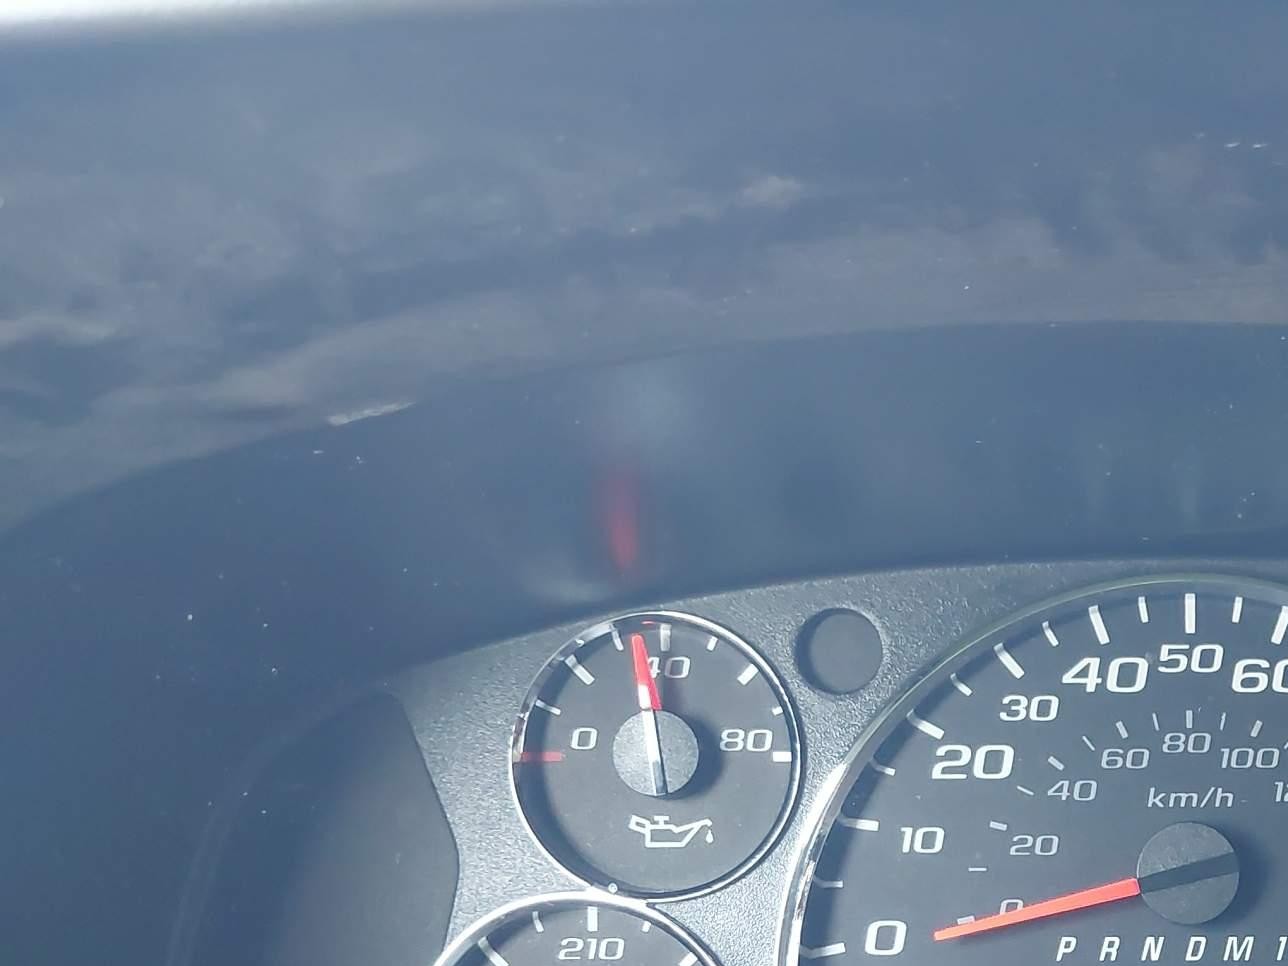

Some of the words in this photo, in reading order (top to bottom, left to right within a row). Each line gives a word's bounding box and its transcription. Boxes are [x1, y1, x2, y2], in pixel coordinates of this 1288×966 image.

[1158, 644, 1223, 673] 50
[1062, 657, 1149, 693] 40
[999, 695, 1060, 722] 30
[571, 727, 598, 750] 0
[719, 728, 774, 752] 80
[1162, 732, 1212, 753] 80
[931, 744, 1015, 780] 20
[1101, 748, 1150, 769] 60
[1220, 747, 1280, 769] 100
[1047, 780, 1098, 801] 40
[1147, 786, 1234, 808] km/h
[900, 826, 945, 854] 10
[1009, 835, 1059, 856] 20
[558, 938, 625, 960] 210
[864, 920, 907, 956] 0
[1056, 936, 1078, 962] P
[1099, 936, 1119, 962] R
[1141, 936, 1165, 962] N
[1185, 936, 1207, 962] D
[1223, 936, 1255, 962] M
[1276, 936, 1288, 962] 1
